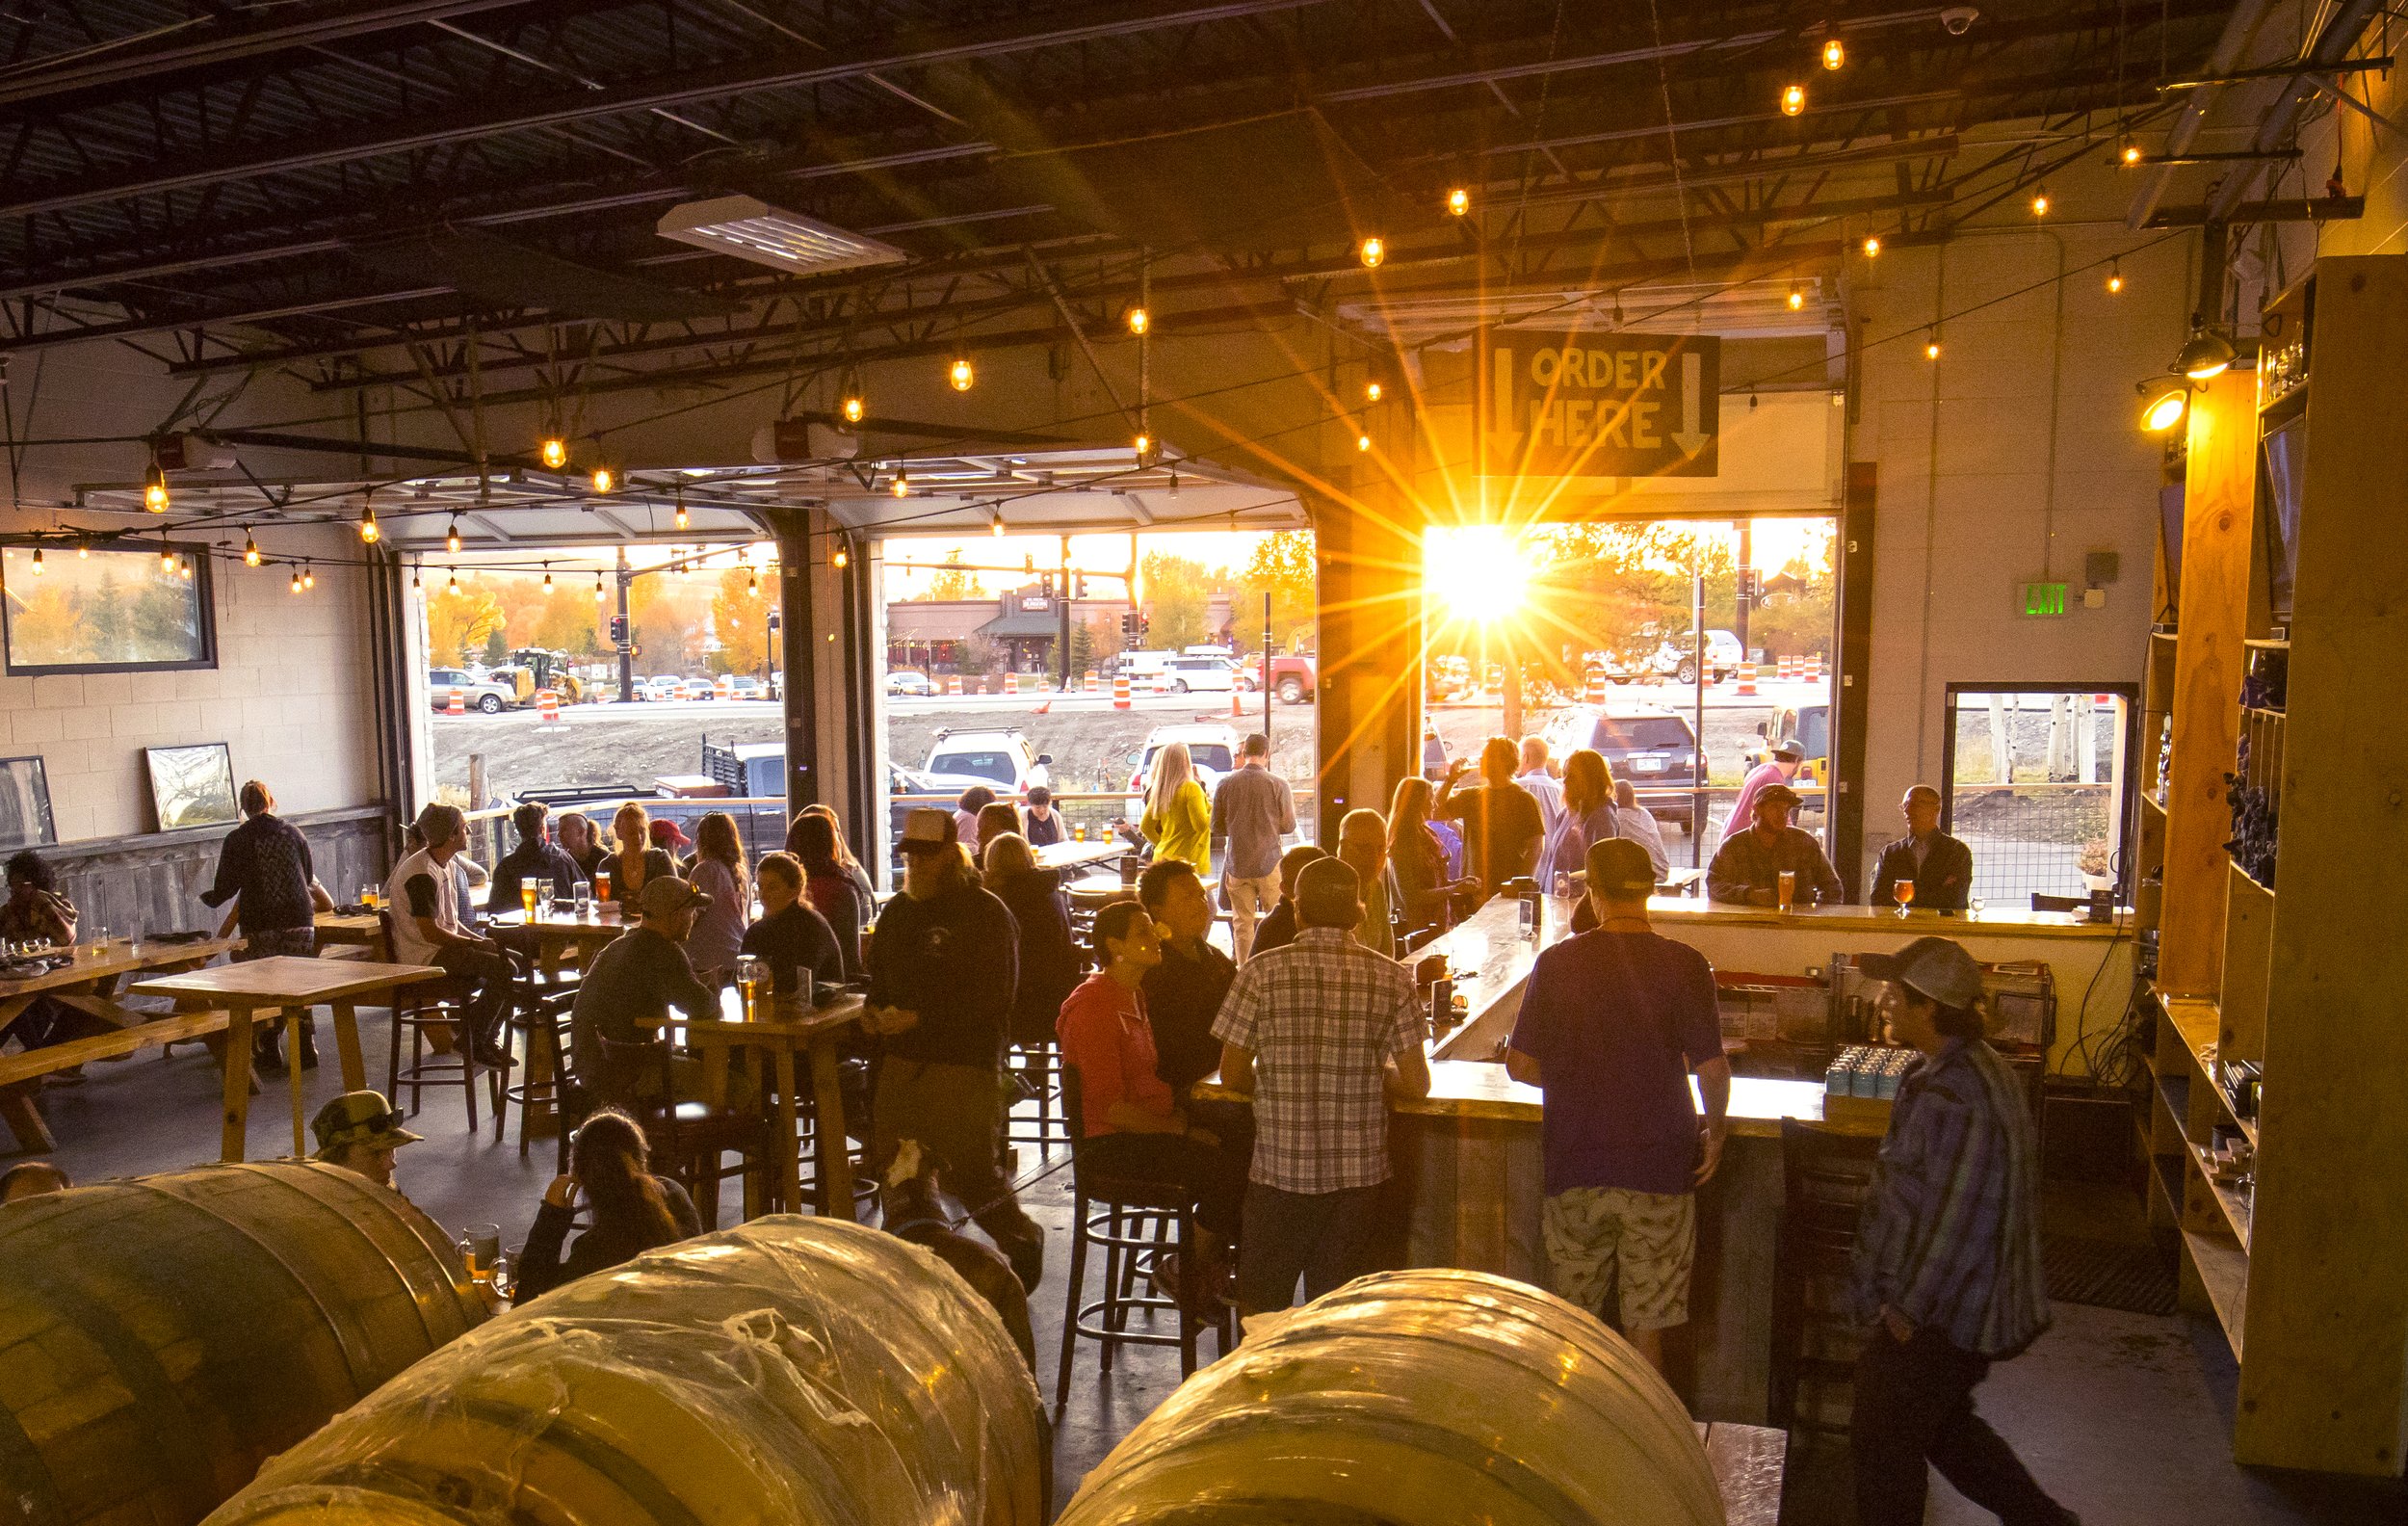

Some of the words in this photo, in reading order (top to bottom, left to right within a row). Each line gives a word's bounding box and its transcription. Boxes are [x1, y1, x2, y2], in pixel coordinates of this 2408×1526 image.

[1531, 348, 1665, 389] ORDER
[1531, 400, 1662, 449] HERE
[2026, 585, 2066, 615] EXIT
